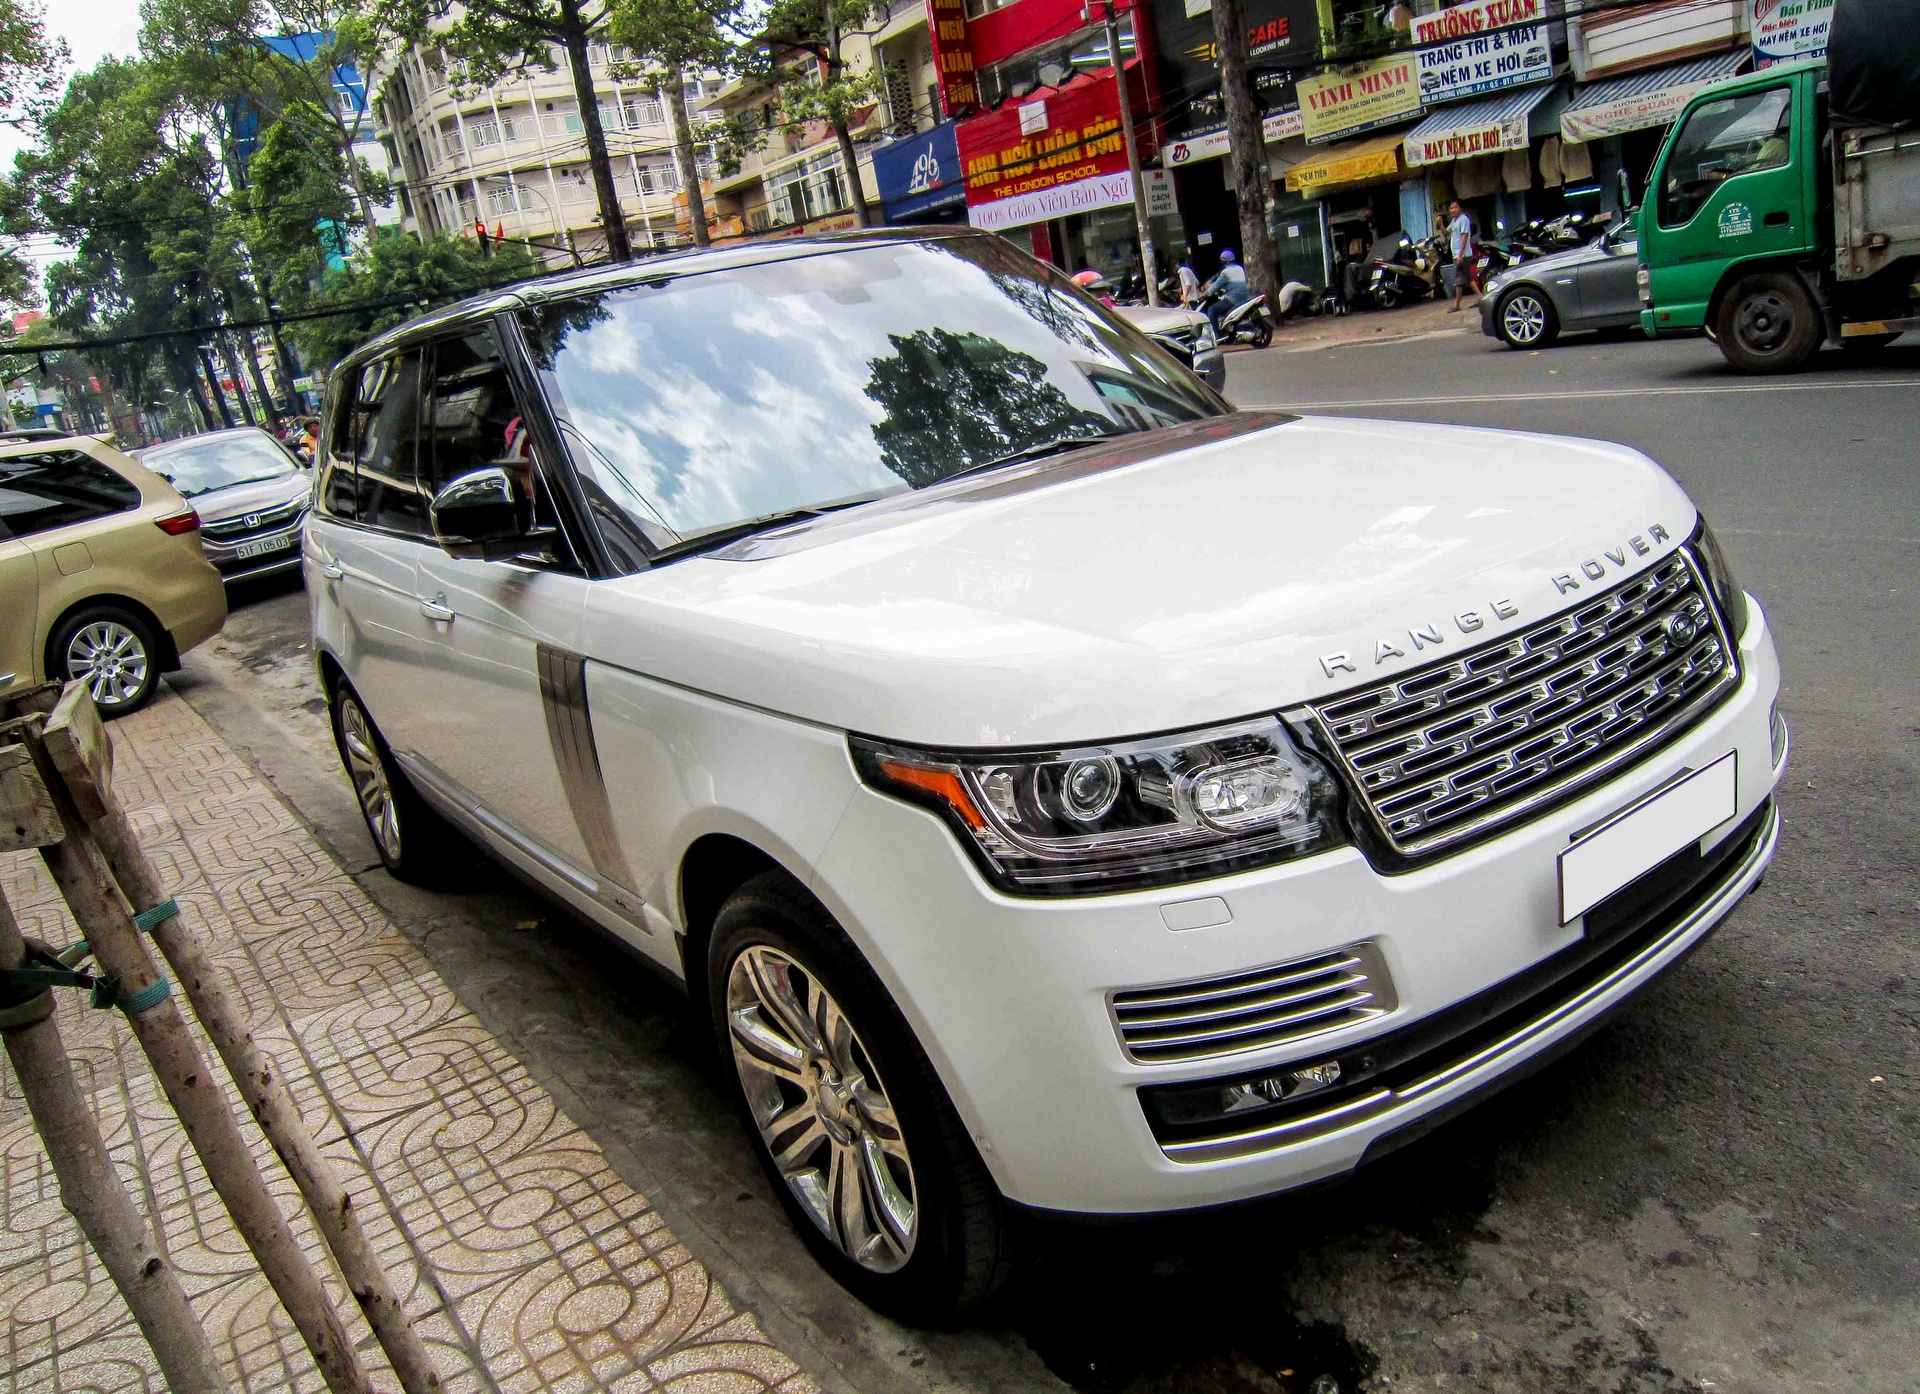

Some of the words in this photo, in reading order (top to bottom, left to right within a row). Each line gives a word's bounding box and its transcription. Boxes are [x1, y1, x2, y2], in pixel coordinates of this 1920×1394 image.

[1780, 3, 1802, 18] Dán
[1417, 7, 1483, 43] TRƯỜNG
[1759, 34, 1776, 47] MAY
[1778, 29, 1797, 43] NỆM
[1800, 27, 1810, 38] XE
[1812, 21, 1827, 35] HƠI
[1252, 41, 1277, 56] LOOKING
[1277, 36, 1291, 48] NEW
[1419, 43, 1463, 68] TRANG
[1493, 35, 1504, 51] &
[1508, 25, 1539, 47] MAY
[940, 48, 974, 73] LUÂN
[1440, 64, 1471, 88] NỆM
[1474, 60, 1492, 79] XE
[1497, 51, 1521, 73] HƠI
[1308, 82, 1354, 112] VĨNH
[1359, 64, 1410, 96] MINH
[1637, 94, 1686, 113] QUANG
[968, 153, 1001, 189] ANH
[1036, 127, 1083, 171] LUÂN
[1424, 140, 1445, 160] MAY
[1468, 132, 1481, 154] XE
[993, 185, 1014, 198] THE
[1014, 175, 1056, 193] LONDON
[1056, 164, 1101, 183] SCHOOL
[1151, 183, 1168, 192] PHIM
[1153, 171, 1164, 180] 3M
[977, 210, 1006, 228] 100%
[1008, 198, 1037, 221] Giáo
[1038, 192, 1068, 213] Viên
[1070, 184, 1097, 207] Bản
[1100, 177, 1129, 202] Ngữ
[238, 546, 254, 558] 51F
[1318, 599, 1519, 679] RANGE
[1551, 523, 1670, 596] ROVER
